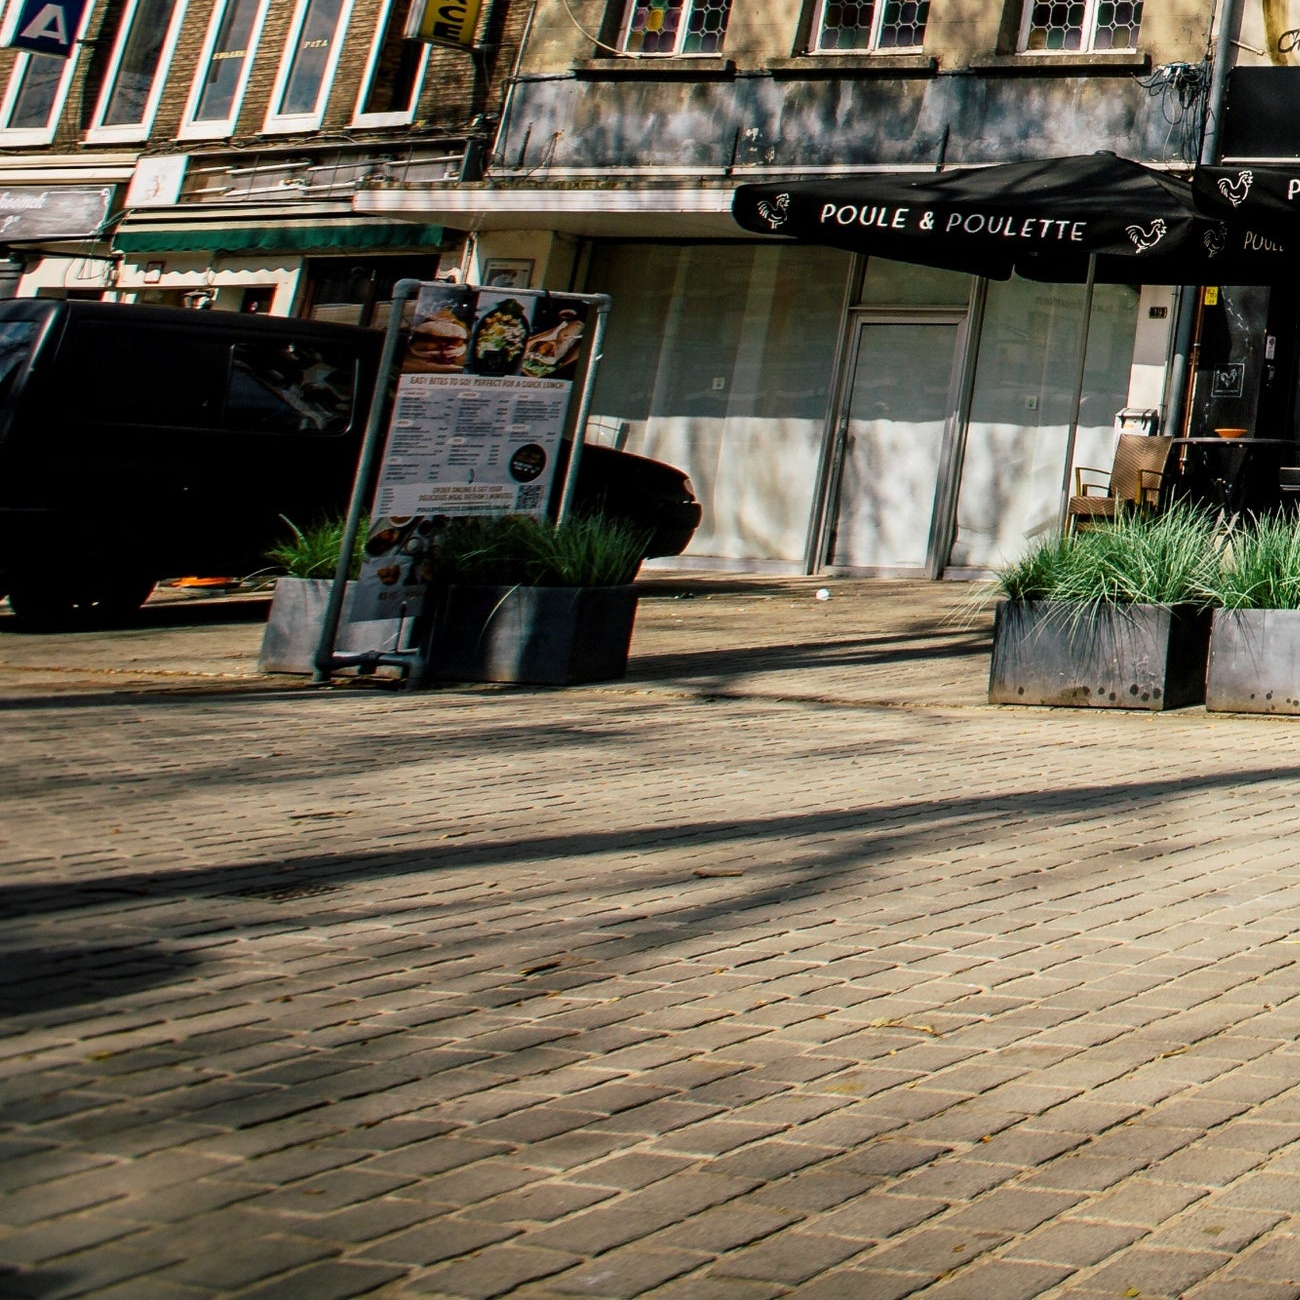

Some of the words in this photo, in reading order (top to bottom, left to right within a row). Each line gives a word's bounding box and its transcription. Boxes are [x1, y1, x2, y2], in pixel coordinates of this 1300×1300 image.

[820, 203, 910, 228] POULE
[919, 211, 935, 230] &
[946, 213, 1088, 241] POULETTE
